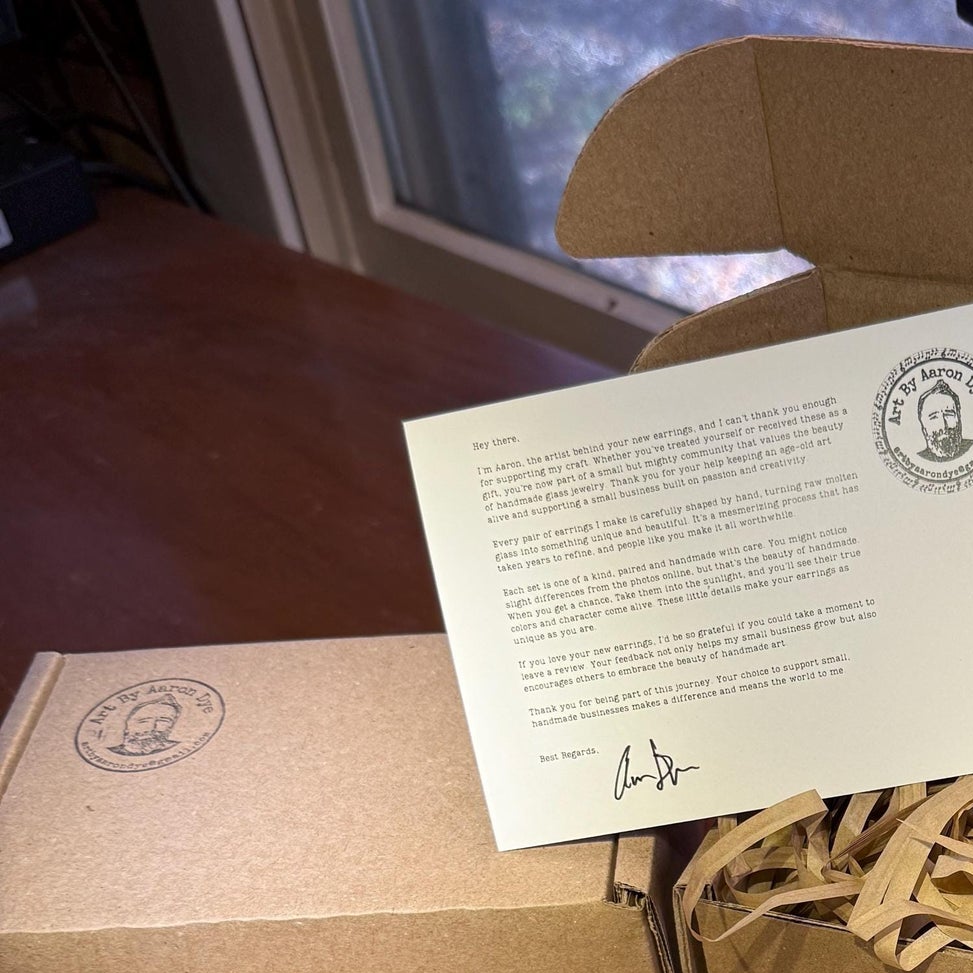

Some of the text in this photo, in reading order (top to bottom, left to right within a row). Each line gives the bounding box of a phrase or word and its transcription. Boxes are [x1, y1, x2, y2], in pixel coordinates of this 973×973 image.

[888, 398, 904, 426] Art
[899, 377, 917, 396] By
[920, 367, 964, 382] Aaron
[472, 441, 490, 451] Hey
[496, 467, 547, 485] supporting
[592, 451, 632, 465] Whether
[666, 436, 701, 451] treated
[702, 427, 743, 446] yourself
[757, 416, 798, 433] received
[799, 412, 826, 424] these
[544, 450, 571, 462] artist
[572, 442, 605, 456] behind
[750, 407, 780, 421] thank
[801, 396, 837, 411] enough
[597, 464, 624, 477] small
[644, 455, 678, 468] mighty
[680, 443, 734, 461] community
[759, 432, 791, 445] values
[811, 421, 844, 435] beauty
[487, 470, 738, 524] alive supporting small business built passion
[495, 439, 815, 510] handmade glass Thank keeping age-old
[492, 472, 859, 549] Every earrings carefully shaped turning molten
[494, 493, 817, 563] glass something unique mesmerizing process
[496, 562, 524, 573] taken
[525, 557, 552, 569] years
[616, 538, 646, 552] people
[505, 597, 533, 609] slight
[534, 588, 585, 604] differences
[630, 574, 661, 588] photos
[761, 549, 794, 562] beauty
[617, 526, 848, 578] paired handmade might notice
[813, 554, 838, 565] their
[510, 567, 836, 633] colors character These little details earrings
[697, 623, 735, 639] grateful
[767, 612, 793, 625] could
[825, 600, 864, 614] moment
[513, 633, 545, 645] unique
[521, 622, 812, 681] leave feedback helps small business
[523, 643, 769, 693] encourages others embrace beauty handmade
[528, 704, 558, 717] Thank
[594, 694, 621, 705] being
[740, 668, 770, 679] choice
[782, 658, 819, 672] support
[89, 684, 214, 726] Art By Aaron Dye
[531, 680, 769, 728] handmade businesses makes difference means
[539, 753, 559, 763] Best
